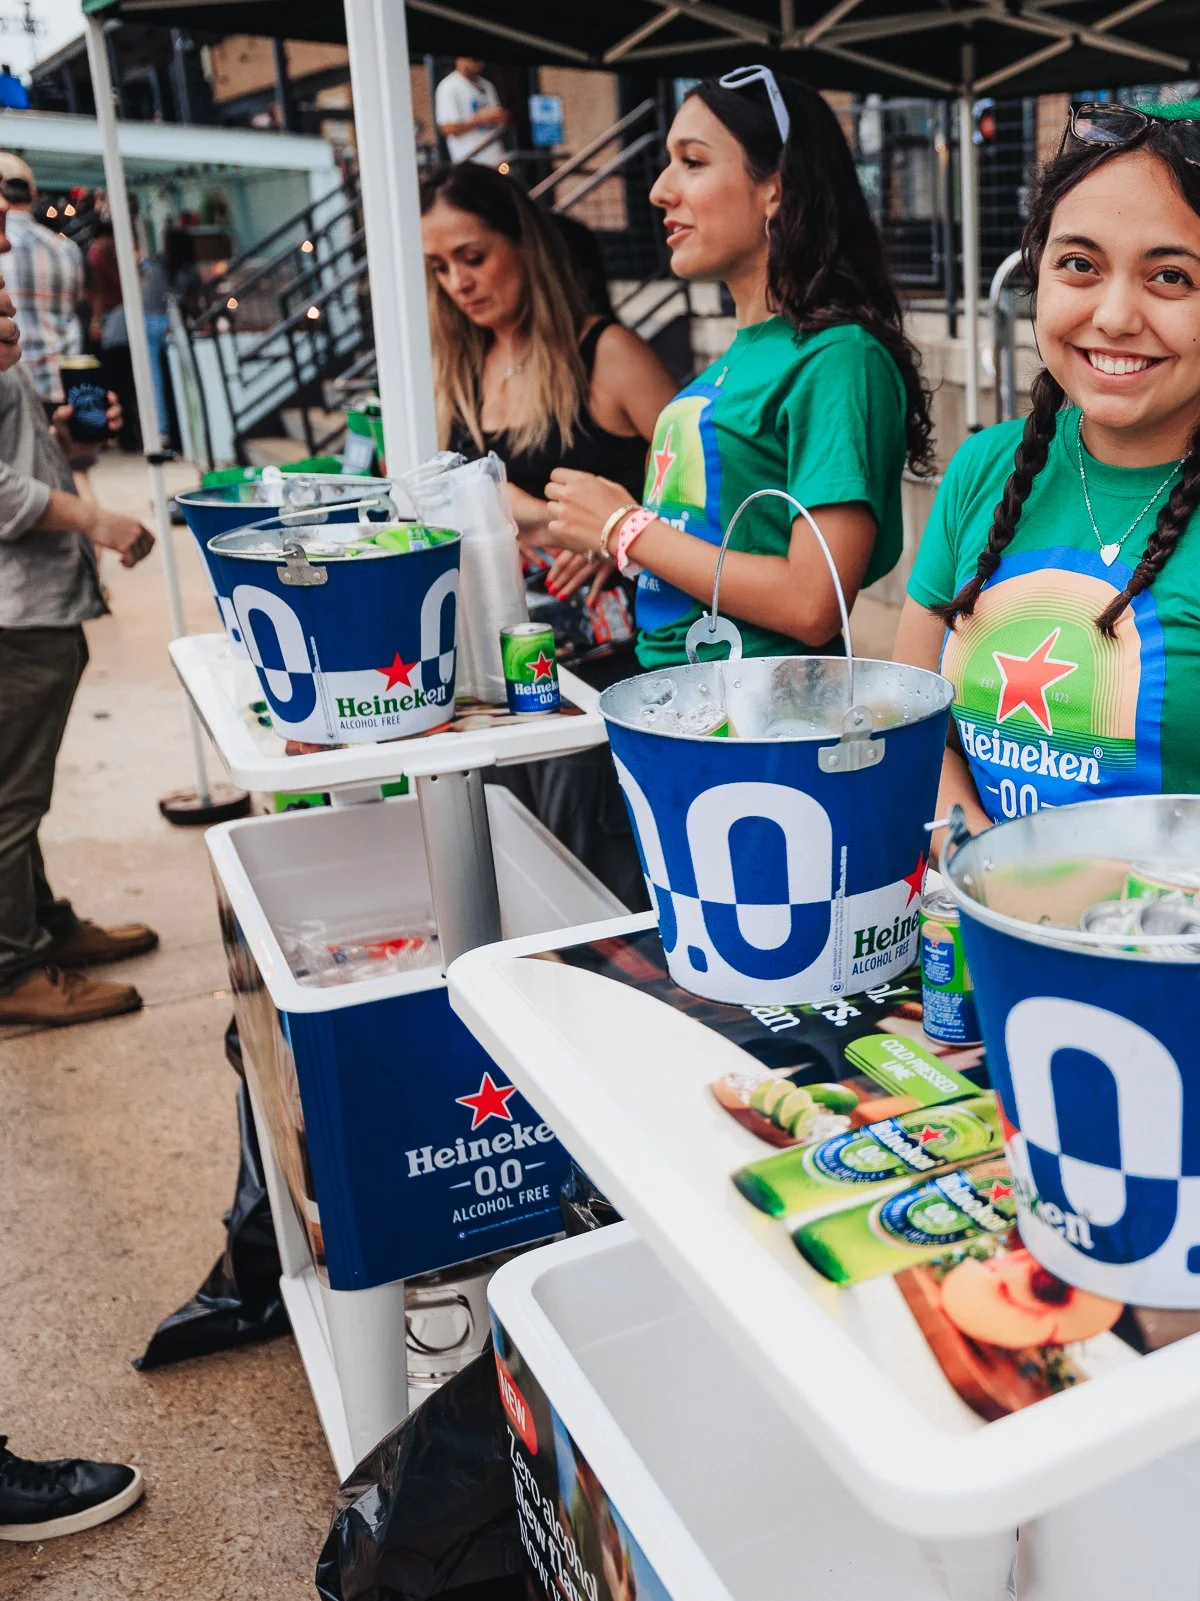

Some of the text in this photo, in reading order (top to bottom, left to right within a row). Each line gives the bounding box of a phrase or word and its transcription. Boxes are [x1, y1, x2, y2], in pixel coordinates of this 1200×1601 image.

[336, 686, 446, 718] Heineken
[514, 680, 559, 696] Heinek
[1051, 691, 1069, 704] 1873
[340, 715, 401, 730] ALCOHOL FREE
[853, 909, 920, 959] Heine
[852, 938, 911, 976] ALCOHOL FREE
[880, 1039, 916, 1061] COLD
[405, 1123, 556, 1178] Heineke
[474, 1158, 523, 1196] 0.0
[452, 1196, 514, 1223] ALCOHOL
[518, 1185, 551, 1205] FREE
[499, 1369, 526, 1432] NEW
